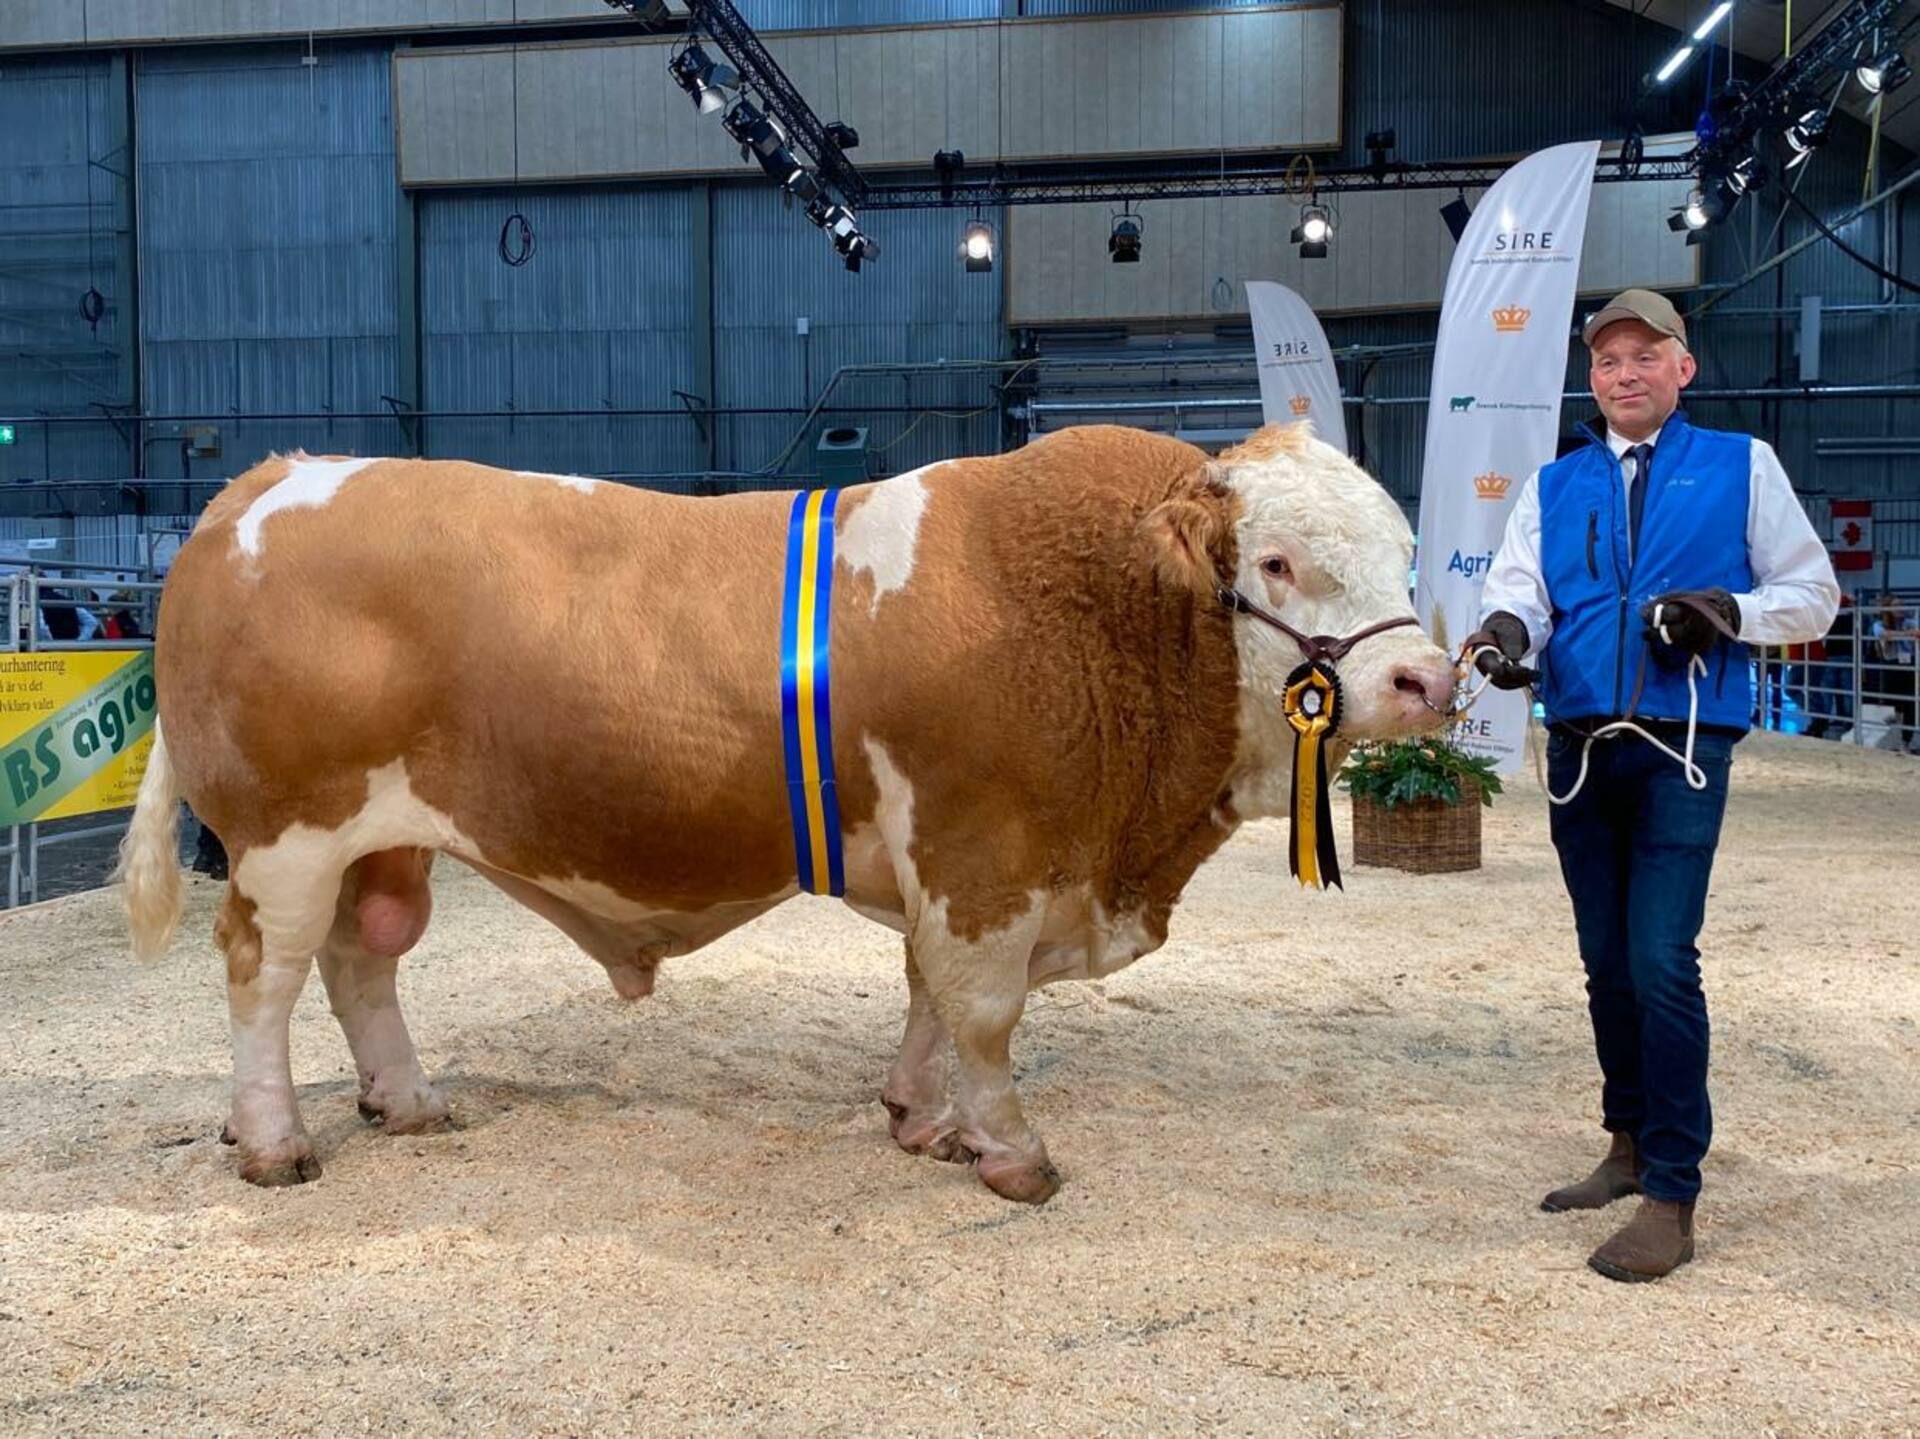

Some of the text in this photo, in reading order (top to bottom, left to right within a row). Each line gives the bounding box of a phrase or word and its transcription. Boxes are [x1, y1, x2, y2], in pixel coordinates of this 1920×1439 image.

[1447, 549, 1493, 578] Agri
[4, 674, 157, 807] BS agro
